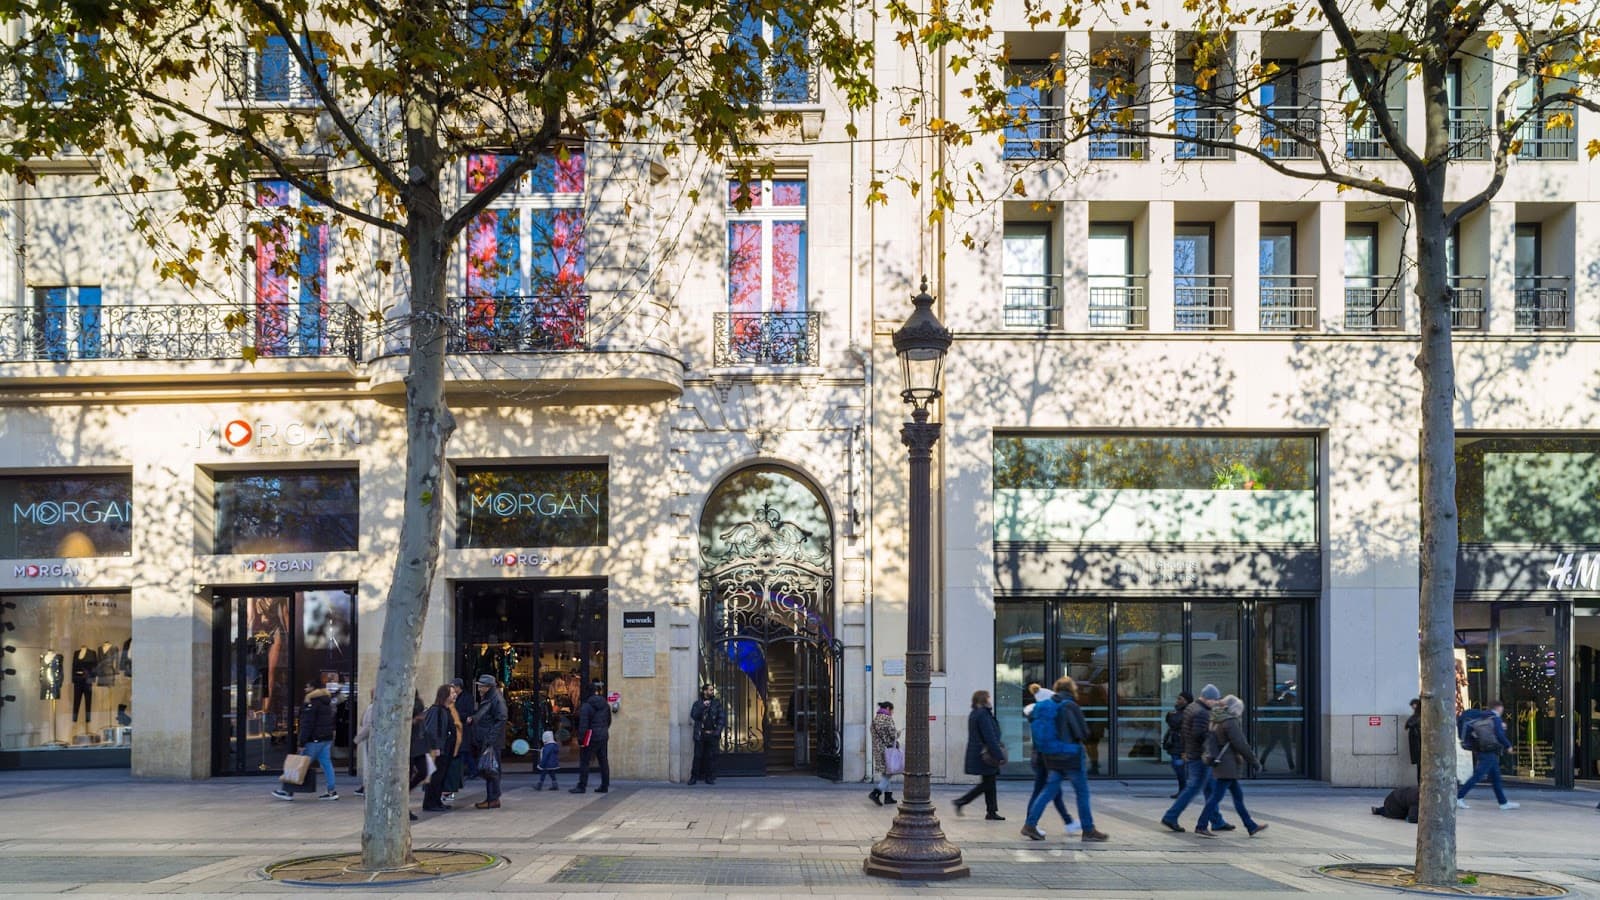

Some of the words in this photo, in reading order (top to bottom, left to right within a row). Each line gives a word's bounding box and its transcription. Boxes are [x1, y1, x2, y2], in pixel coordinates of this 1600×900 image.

[197, 418, 361, 449] MORGAN
[471, 492, 600, 516] MORGAN
[241, 559, 313, 573] MORGAN
[492, 553, 562, 567] MORGAN
[14, 565, 88, 578] MORGAN
[1546, 553, 1600, 590] H&M
